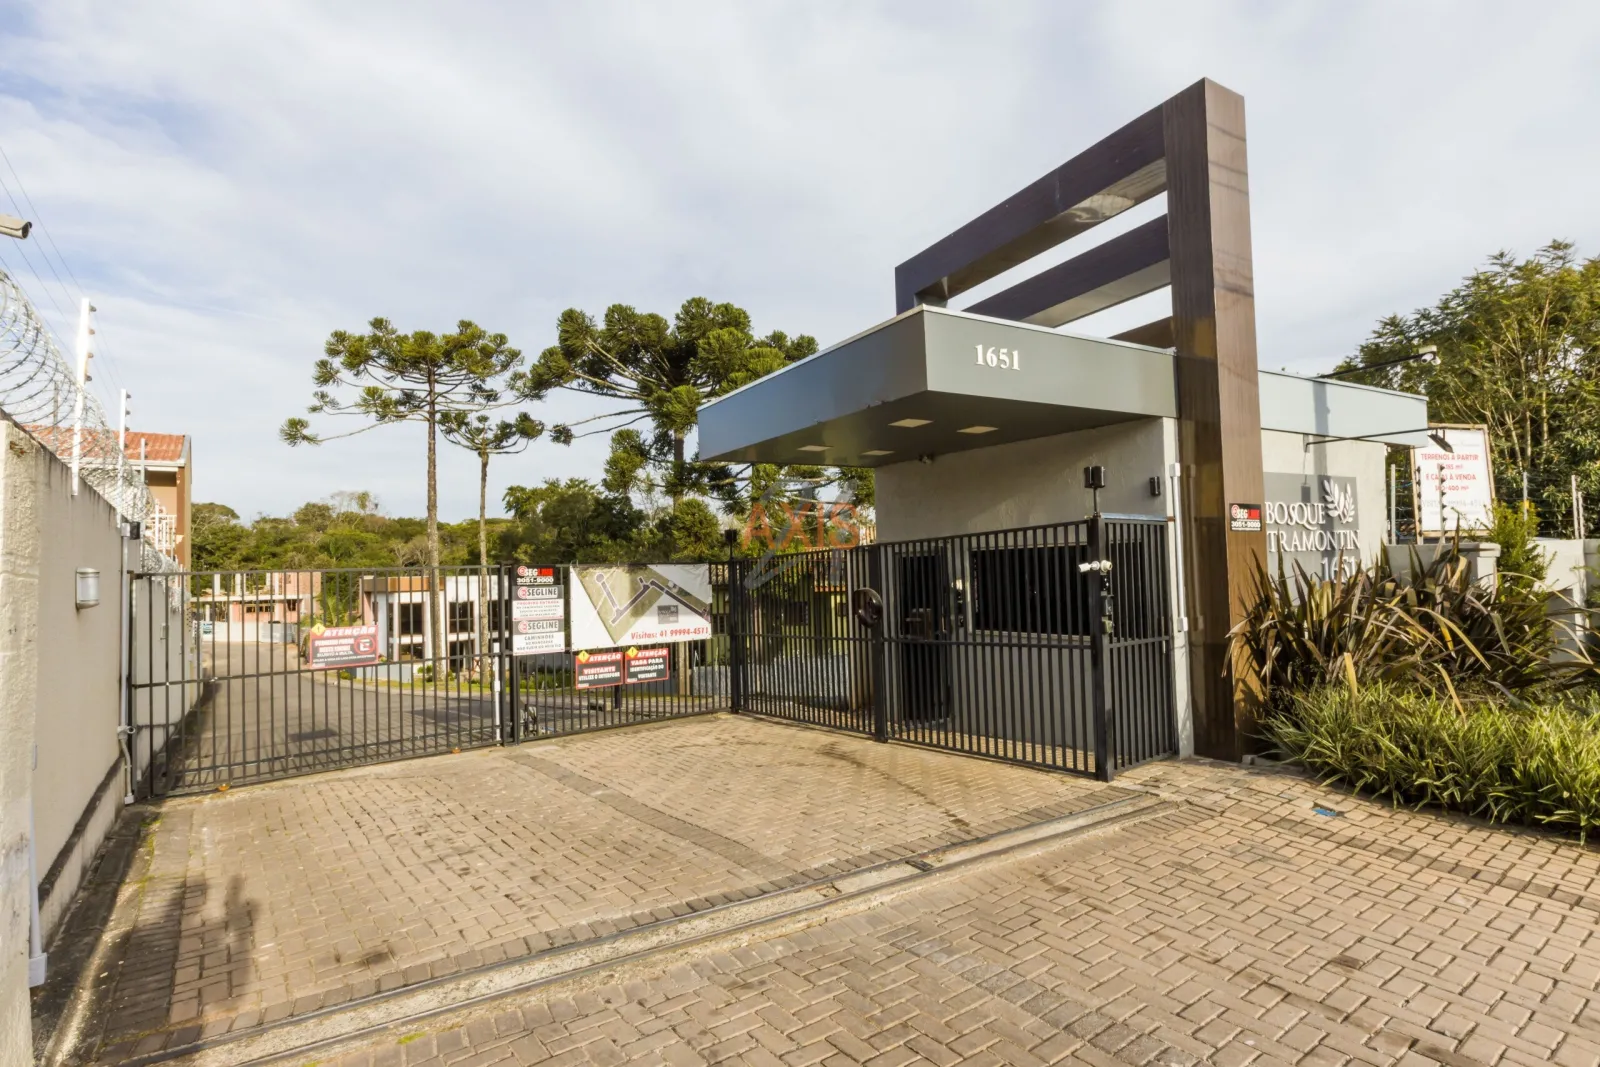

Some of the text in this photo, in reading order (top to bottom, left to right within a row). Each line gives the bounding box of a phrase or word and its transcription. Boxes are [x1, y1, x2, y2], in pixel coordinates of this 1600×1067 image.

[974, 344, 1021, 371] 1651
[1265, 501, 1326, 530] BOSQUE
[1267, 530, 1361, 552] TRAMONTIN
[527, 588, 557, 597] SEGLINE
[528, 621, 558, 631] SEGLINE
[631, 631, 657, 640] Visitas:
[589, 653, 621, 662] ATENÇÃO
[638, 650, 668, 658] ATENÇÃO
[583, 666, 616, 675] VISITANTE
